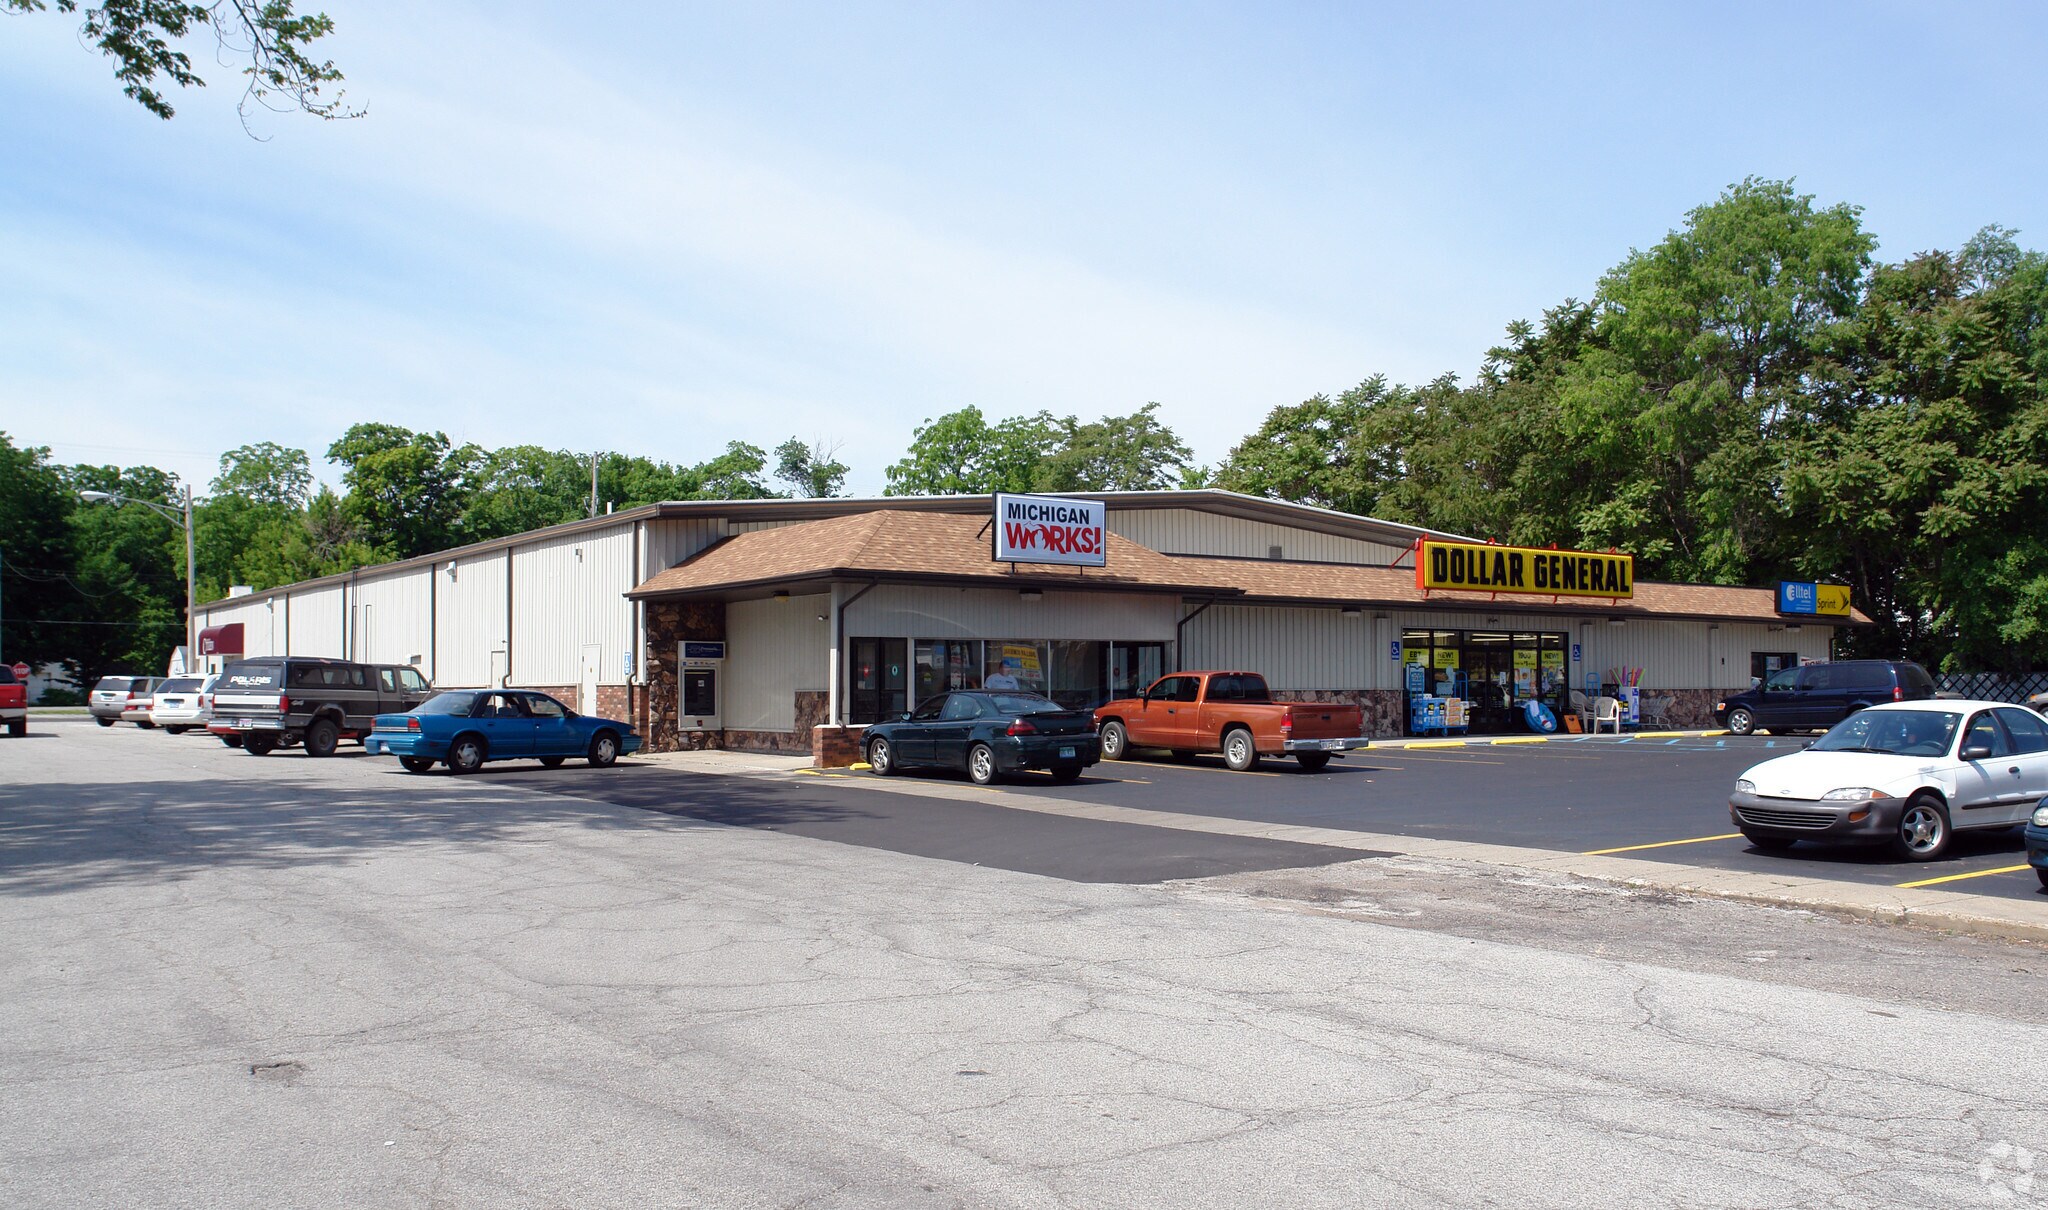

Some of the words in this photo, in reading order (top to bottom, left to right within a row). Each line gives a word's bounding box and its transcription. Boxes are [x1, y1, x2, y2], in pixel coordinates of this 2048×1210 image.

[1008, 503, 1090, 525] MICHIGAN
[1005, 522, 1101, 554] WORKS!
[1432, 547, 1524, 587] DOLLAR
[1534, 555, 1630, 593] GENERAL
[1817, 598, 1836, 611] Sprint
